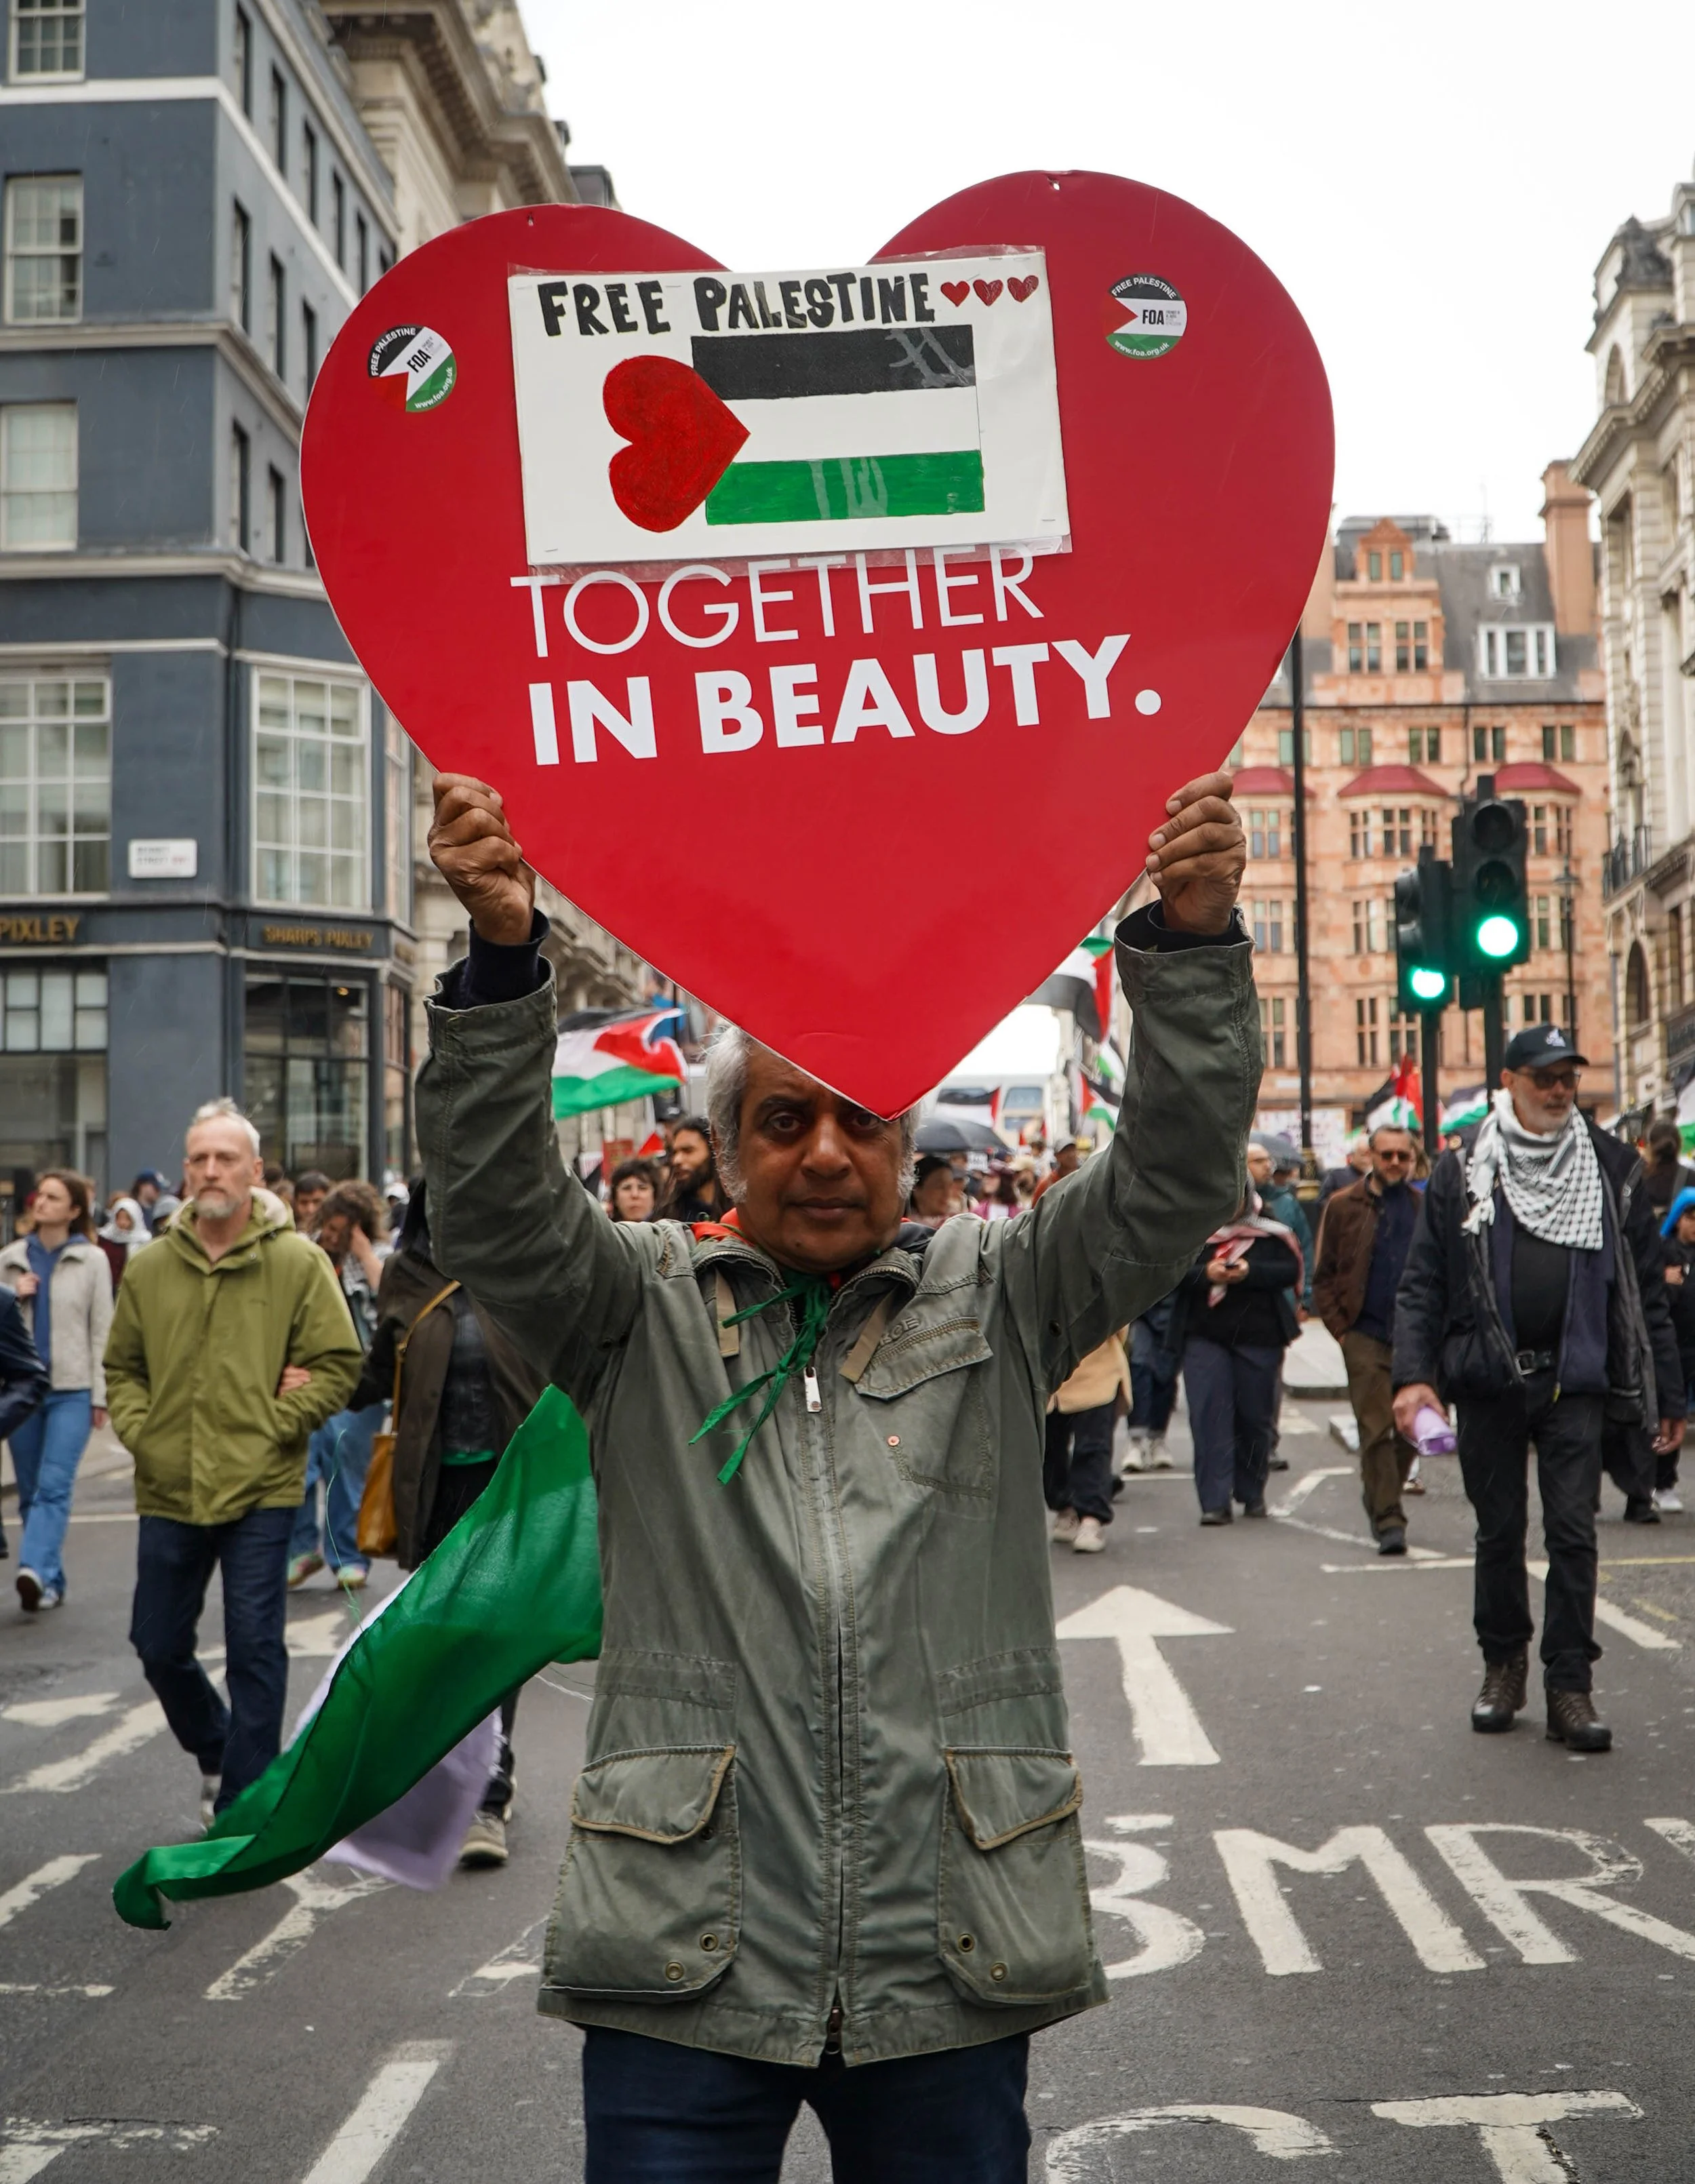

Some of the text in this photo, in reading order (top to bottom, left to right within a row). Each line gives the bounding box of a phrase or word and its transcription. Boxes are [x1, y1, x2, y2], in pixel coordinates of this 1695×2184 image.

[1111, 277, 1177, 299] FREE PALESTINE
[537, 271, 936, 337] FREE PALESTINE
[1142, 309, 1165, 325] FOA
[370, 327, 416, 376] FREE PALESTINE
[406, 349, 432, 374] FOA
[1114, 339, 1170, 357] www.foa.org.uk
[510, 544, 1045, 658] TOGETHER
[528, 633, 1162, 766] IN BEAUTY.
[0, 915, 80, 942] PIXLEY
